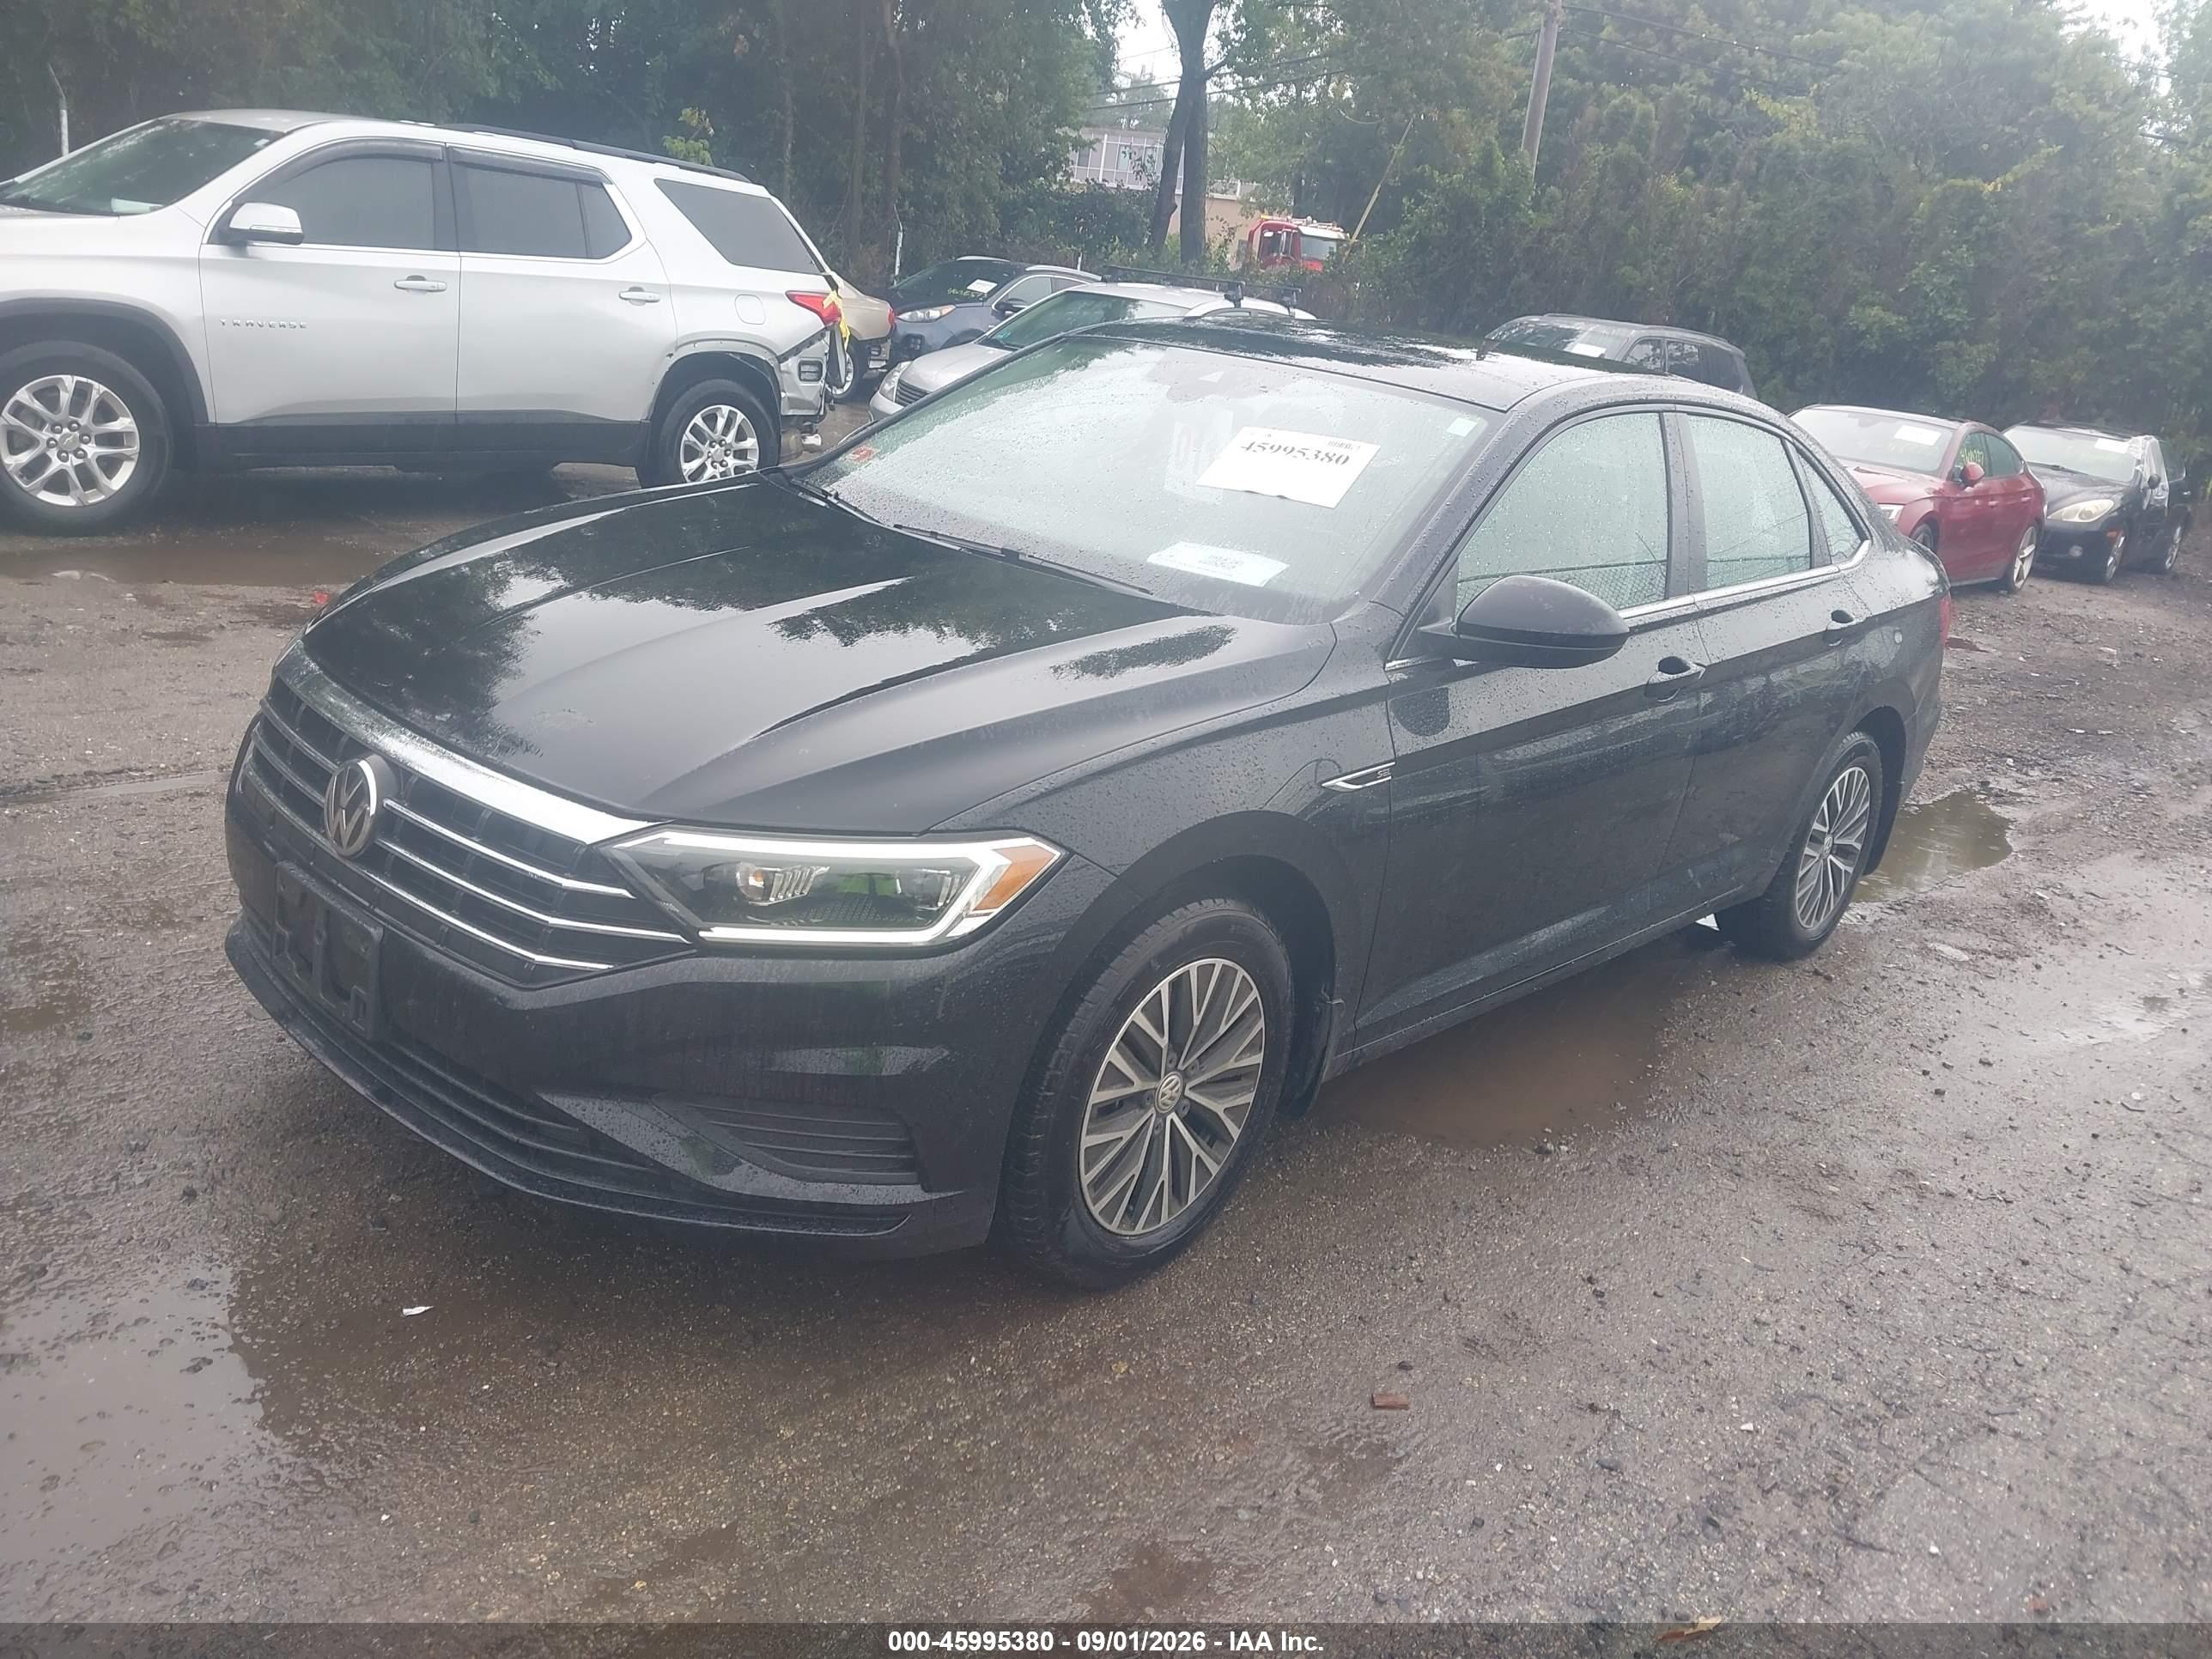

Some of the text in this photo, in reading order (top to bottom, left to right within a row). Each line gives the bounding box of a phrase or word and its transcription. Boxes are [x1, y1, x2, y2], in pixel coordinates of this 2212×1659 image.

[220, 317, 307, 329] TRAVERSE
[1241, 441, 1351, 465] 45995380
[325, 759, 374, 855] VW
